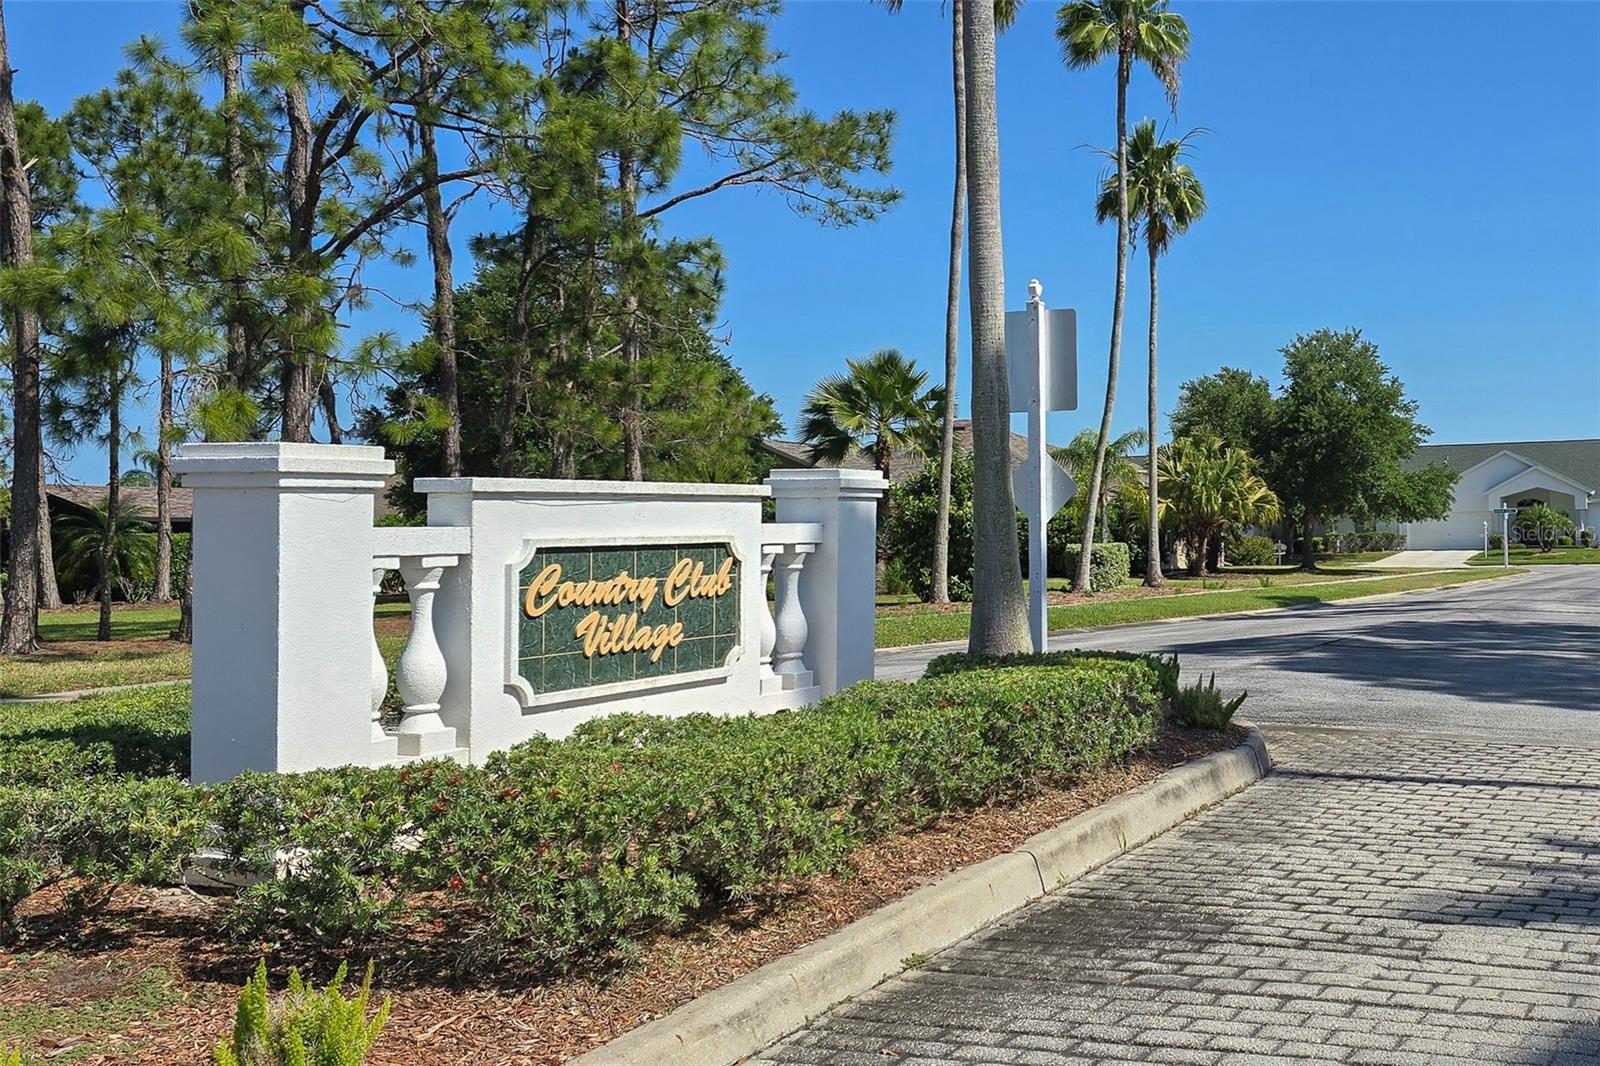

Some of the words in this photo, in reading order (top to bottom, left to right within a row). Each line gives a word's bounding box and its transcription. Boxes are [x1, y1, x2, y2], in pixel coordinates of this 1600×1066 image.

[525, 563, 658, 618] Country
[664, 557, 733, 607] Club
[575, 611, 684, 663] Village
